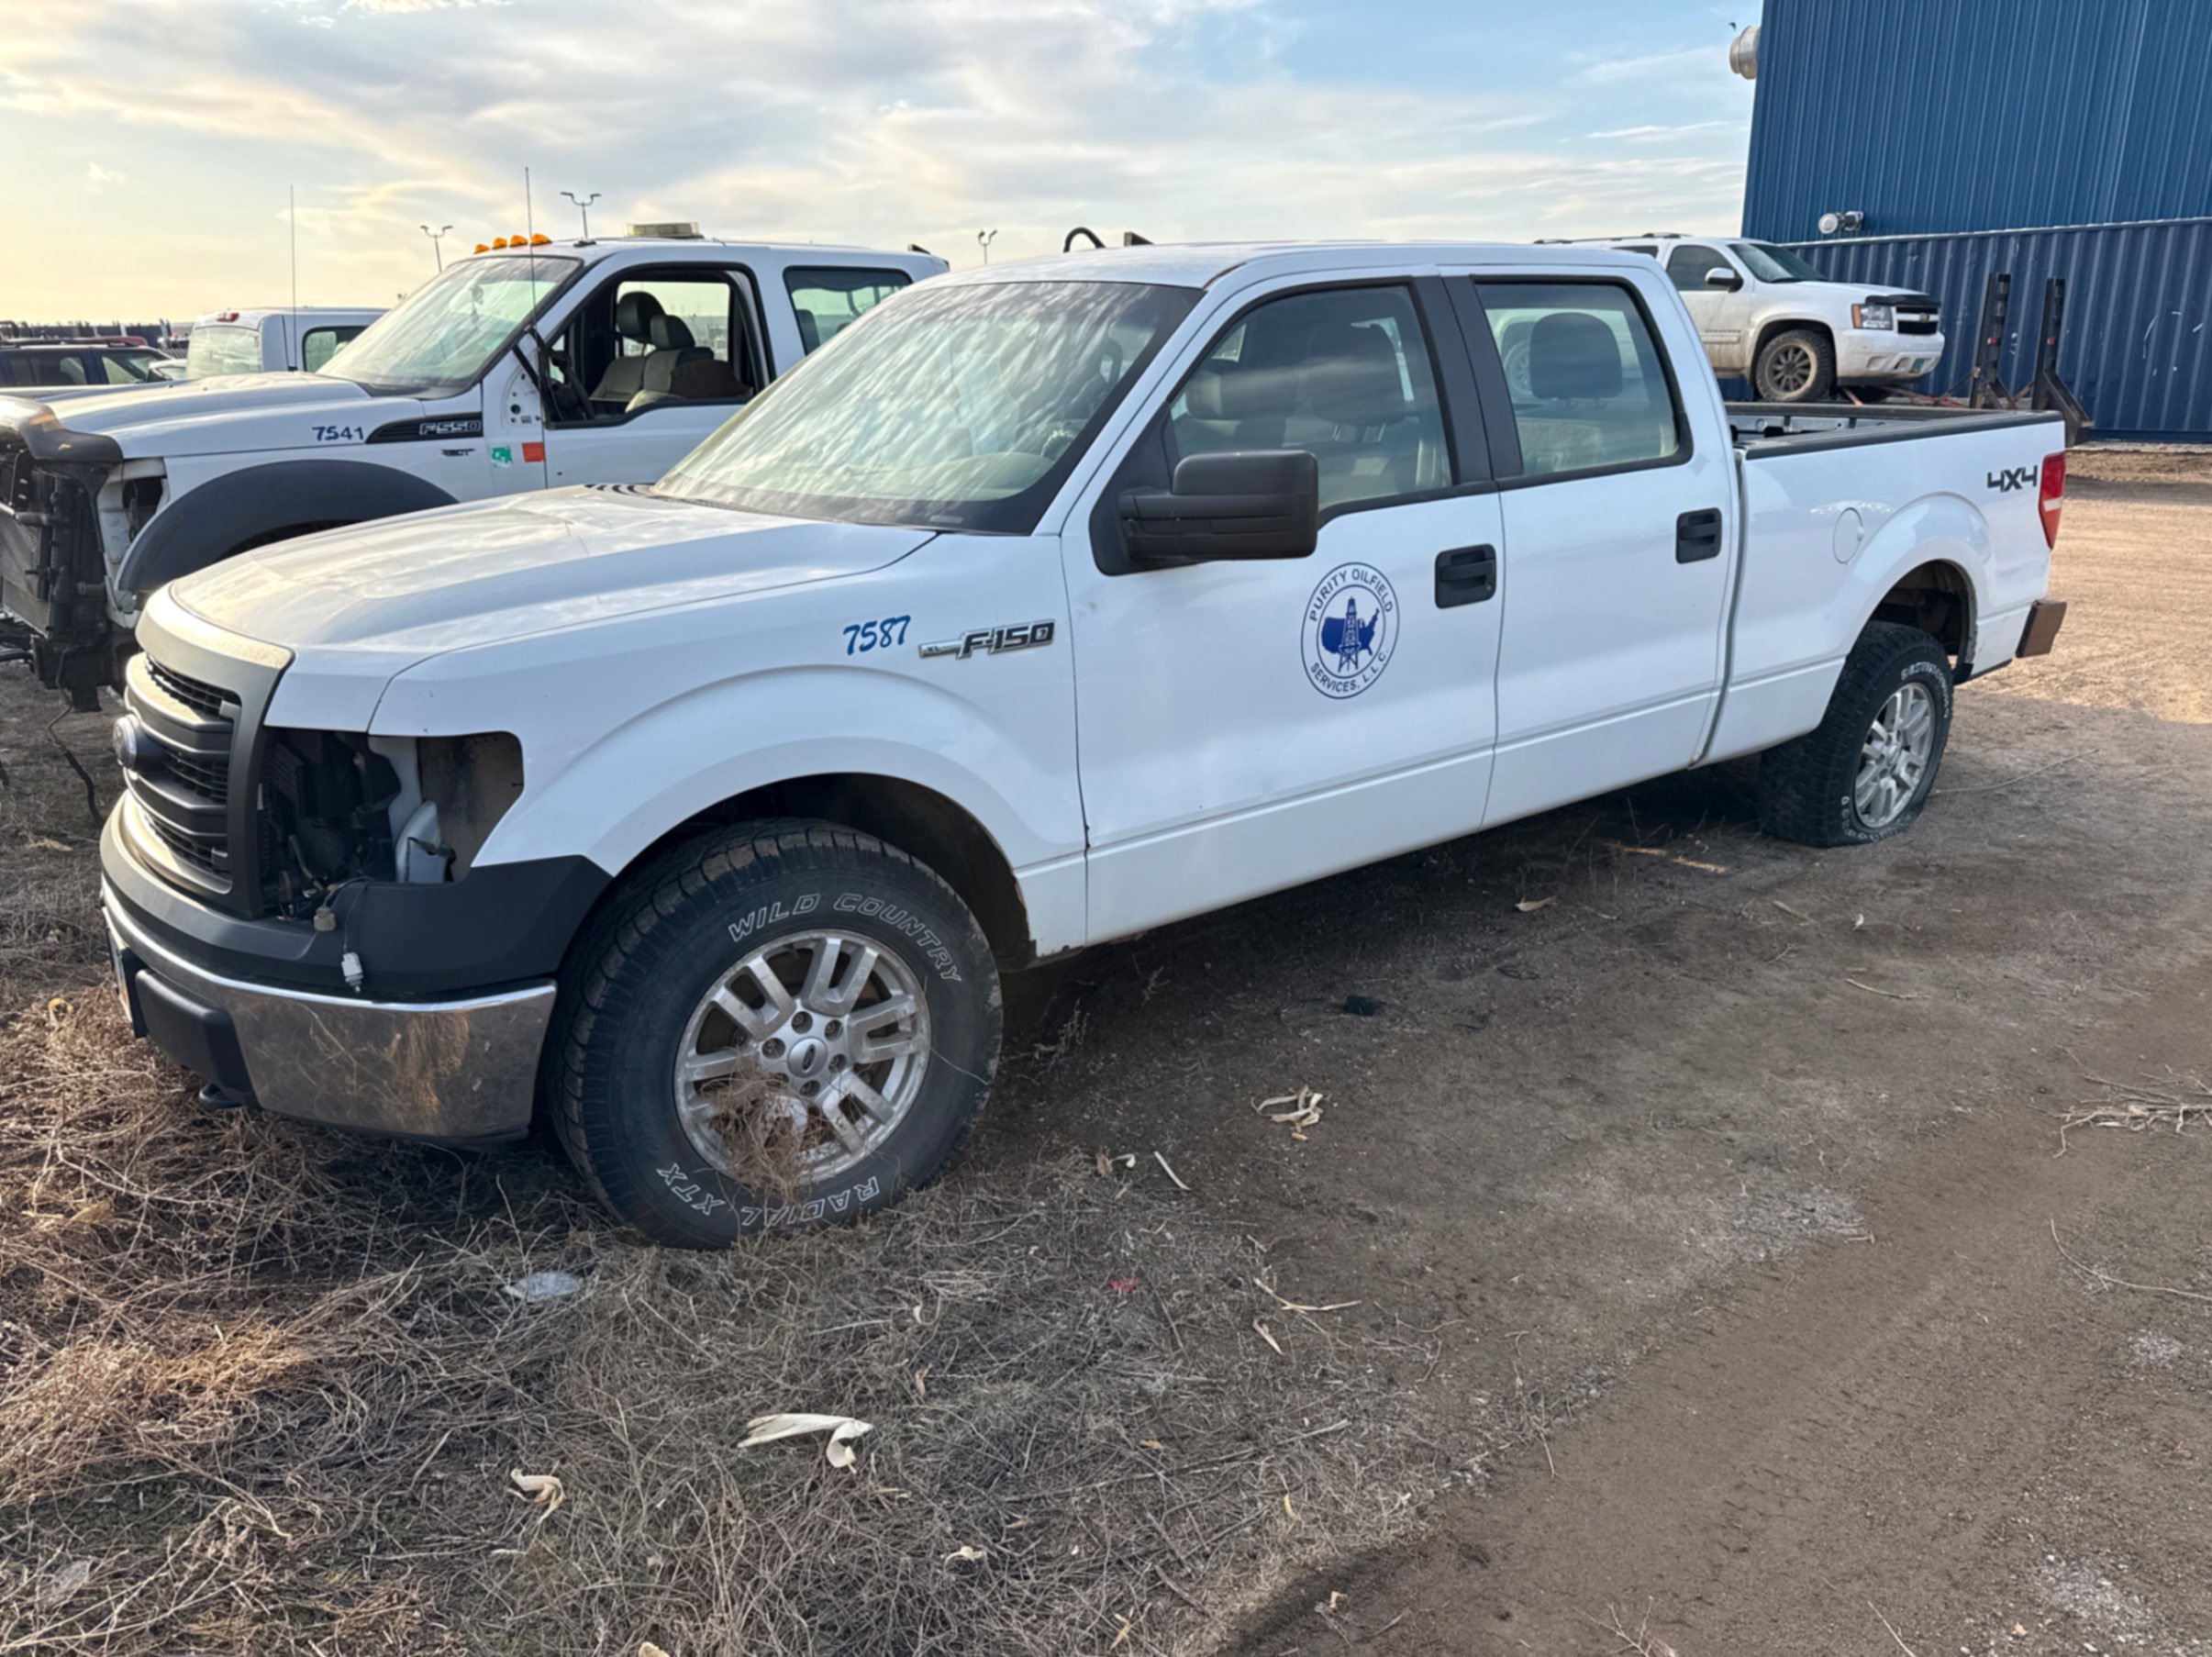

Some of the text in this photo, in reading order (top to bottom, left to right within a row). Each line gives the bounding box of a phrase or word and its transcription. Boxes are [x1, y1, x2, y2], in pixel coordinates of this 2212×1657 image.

[312, 426, 364, 440] 7541
[1309, 568, 1394, 622] PURITY OILFIELD
[842, 615, 911, 655] 7587
[955, 619, 1056, 659] F-150
[728, 893, 961, 983] WILD COUNTRY
[656, 1162, 880, 1227] RADIAL XTX
